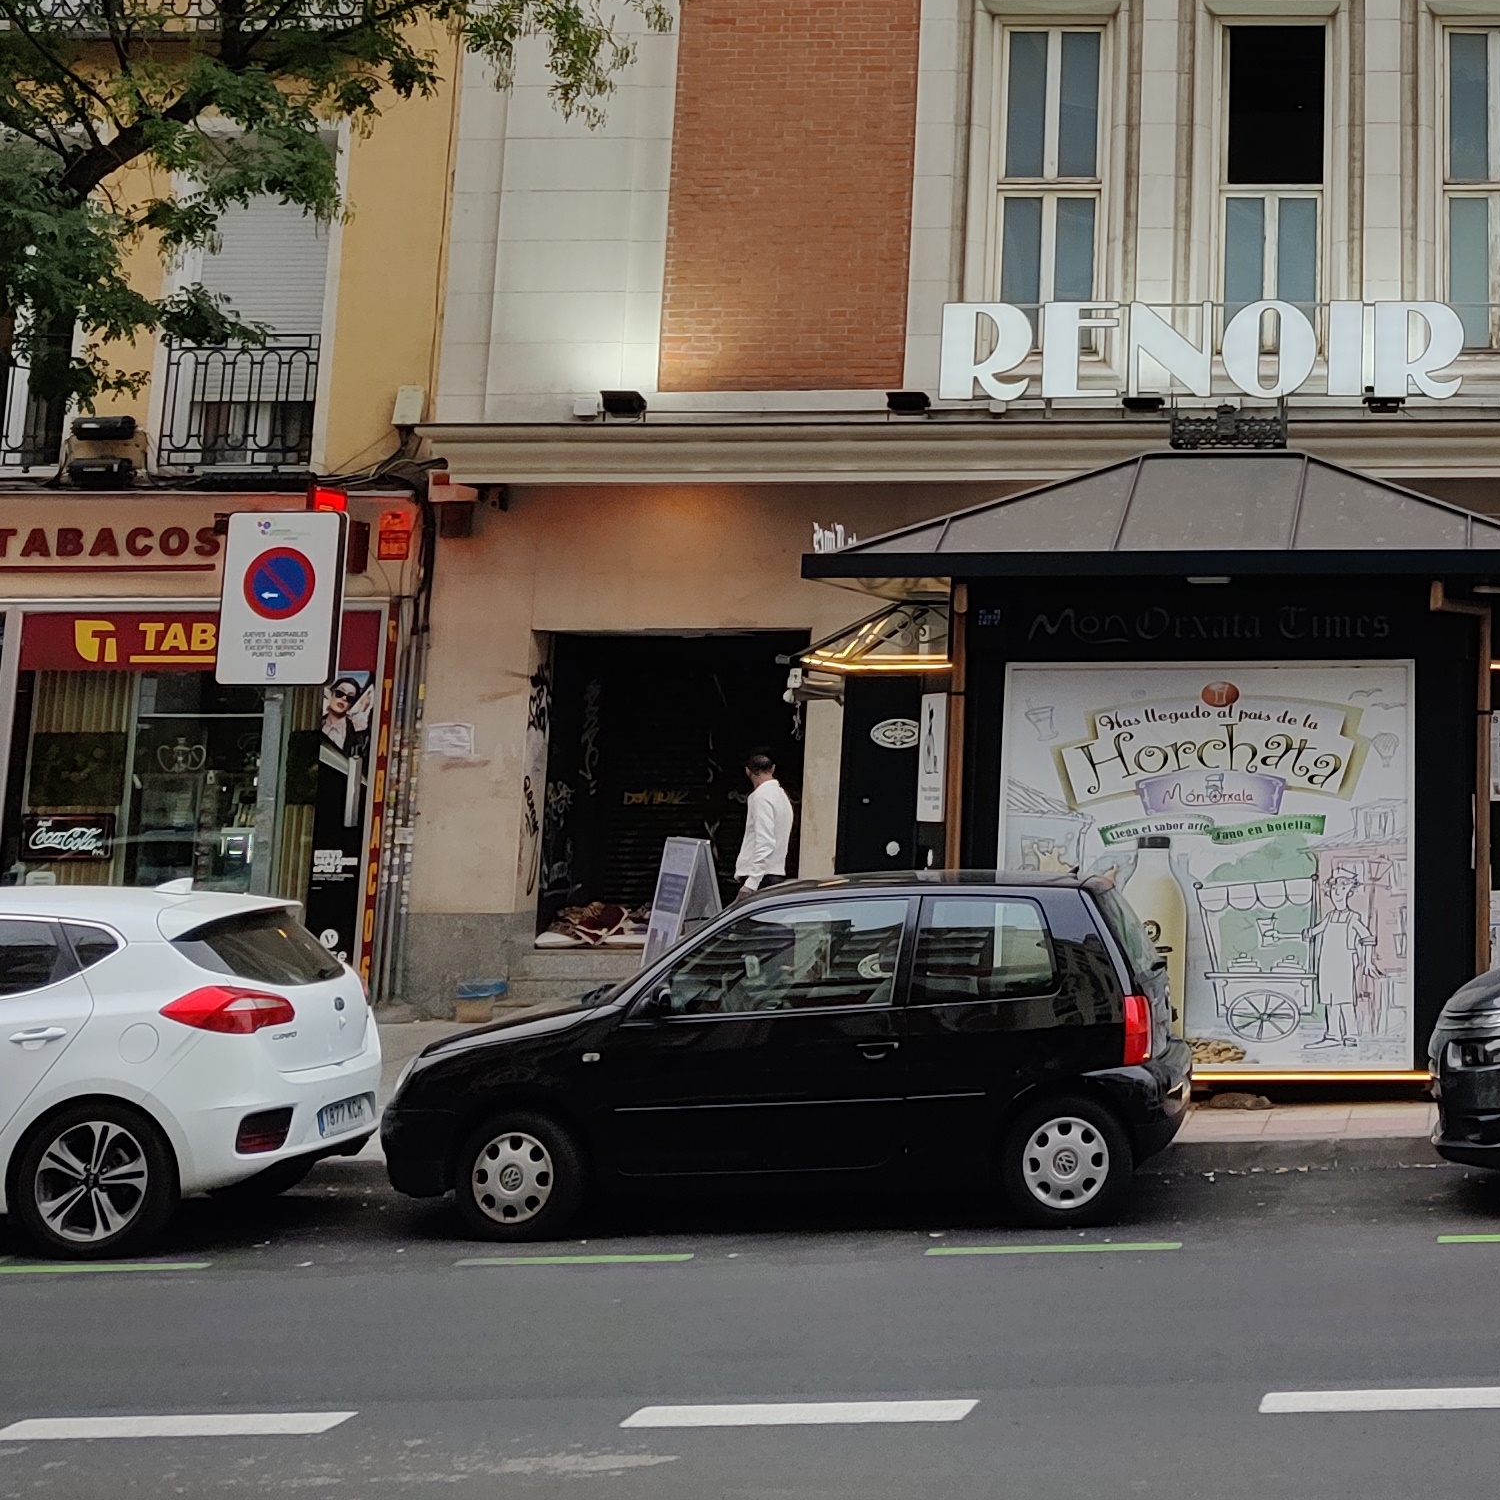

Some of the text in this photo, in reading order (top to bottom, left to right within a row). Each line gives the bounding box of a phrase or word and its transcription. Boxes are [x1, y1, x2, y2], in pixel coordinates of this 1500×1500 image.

[938, 300, 1465, 401] RENOIR
[0, 527, 221, 558] TABACOS
[1136, 606, 1262, 640] Orxata
[1278, 605, 1391, 640] Times
[1098, 711, 1141, 731] Has
[1144, 707, 1212, 724] llegado
[1217, 704, 1234, 720] al
[1276, 710, 1298, 726] de
[1302, 713, 1319, 730] la
[1077, 722, 1342, 795] Horchata
[1142, 822, 1153, 834] el
[1155, 820, 1184, 834] sabor
[1213, 826, 1244, 841] sano
[1248, 825, 1263, 836] en
[1266, 819, 1312, 833] botella
